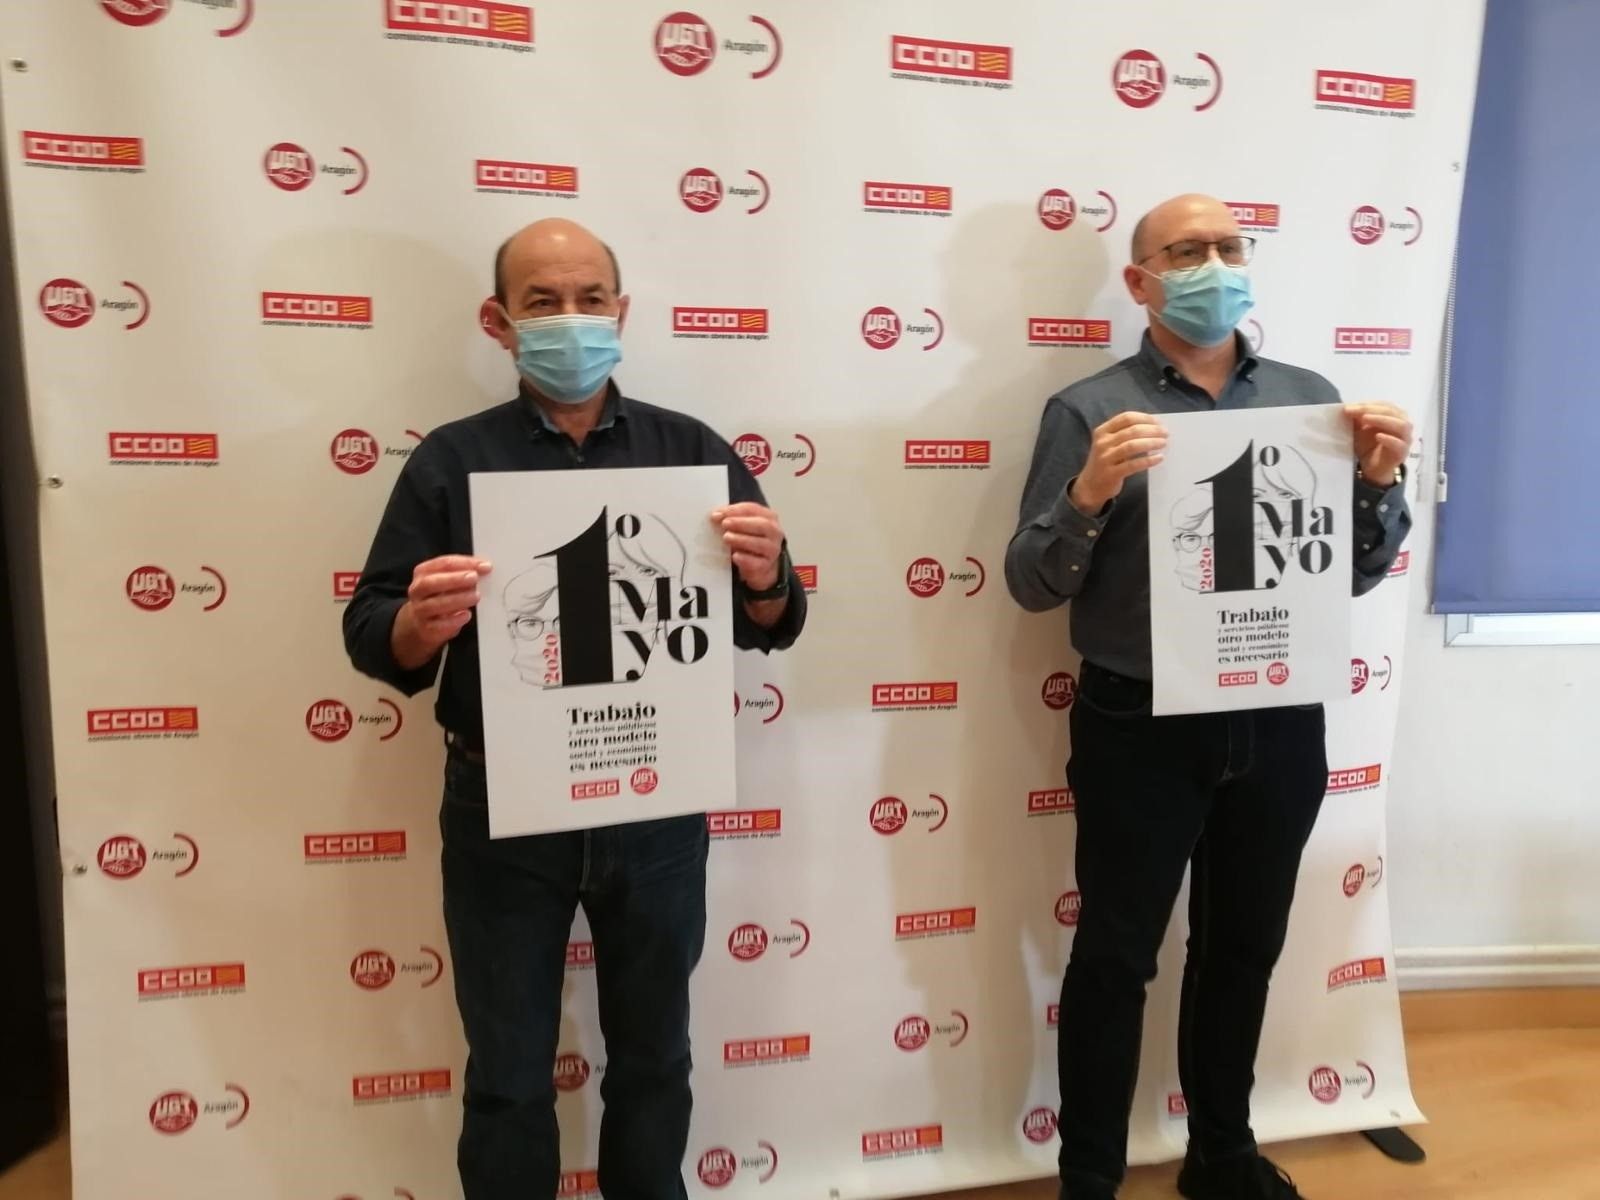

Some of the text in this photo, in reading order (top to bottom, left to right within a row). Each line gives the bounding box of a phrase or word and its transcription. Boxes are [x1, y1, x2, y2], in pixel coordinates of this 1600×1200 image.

[394, 2, 488, 31] CCOO
[662, 24, 768, 54] UGT Aragón
[897, 43, 975, 70] CCOO
[1116, 61, 1211, 88] UGT Aragón
[1321, 77, 1386, 101] CCOO
[28, 137, 109, 159] CCOO
[269, 152, 357, 177] UGT Aragón
[481, 166, 549, 185] CCOO
[684, 177, 760, 197] UGT Aragón
[868, 187, 926, 204] CCOO
[1041, 197, 1109, 216] UGT Aragón
[1232, 208, 1256, 222] OO
[1353, 213, 1380, 229] UGT
[45, 288, 138, 311] UGT Aragón
[266, 297, 340, 316] CCOO
[677, 312, 739, 327] CCOO
[865, 314, 934, 335] UGT Aragón
[1032, 323, 1086, 338] CCOO
[1338, 332, 1388, 344] CCOO
[113, 437, 185, 453] CCOO
[335, 437, 373, 456] UGT
[909, 445, 964, 458] CCOO
[776, 449, 807, 461] Aragón
[1254, 499, 1334, 538] Ma
[1200, 547, 1213, 590] 2020
[1256, 539, 1333, 589] yo
[910, 565, 977, 583] UGT Aragón
[131, 574, 215, 595] UGT Aragón
[609, 576, 708, 624] Ma
[1217, 606, 1288, 624] Trabajo
[1218, 631, 1289, 643] otro modelo
[541, 633, 560, 684] 2020
[610, 624, 709, 684] yo
[1218, 650, 1289, 664] es necesario
[1221, 673, 1256, 686] CCOO
[1352, 665, 1365, 679] GT
[875, 687, 930, 701] CCOO
[1046, 680, 1072, 695] UGT
[744, 698, 774, 710] Aragón
[93, 713, 168, 731] CCOO
[310, 707, 392, 725] UGT Aragón
[566, 702, 656, 725] Trabajo
[568, 730, 656, 748] otro modelo
[569, 749, 596, 759] social
[570, 753, 656, 772] es necesario
[574, 781, 617, 798] CCOO
[874, 804, 939, 820] UGT Aragón
[706, 815, 753, 830] COO
[102, 843, 187, 862] UGT Aragón
[309, 837, 376, 855] CCOO
[1059, 895, 1079, 912] UG
[900, 914, 950, 933] CCOO
[732, 931, 801, 947] UGT Aragón
[355, 958, 390, 975] UGT
[143, 970, 212, 988] CCOO
[899, 1023, 926, 1038] UGT
[359, 1074, 420, 1096] CCOO
[1312, 1071, 1367, 1088] UGT Aragón
[154, 1099, 238, 1117] UGT Aragón
[1026, 1115, 1053, 1129] UGT
[701, 1155, 768, 1172] UGT Aragón
